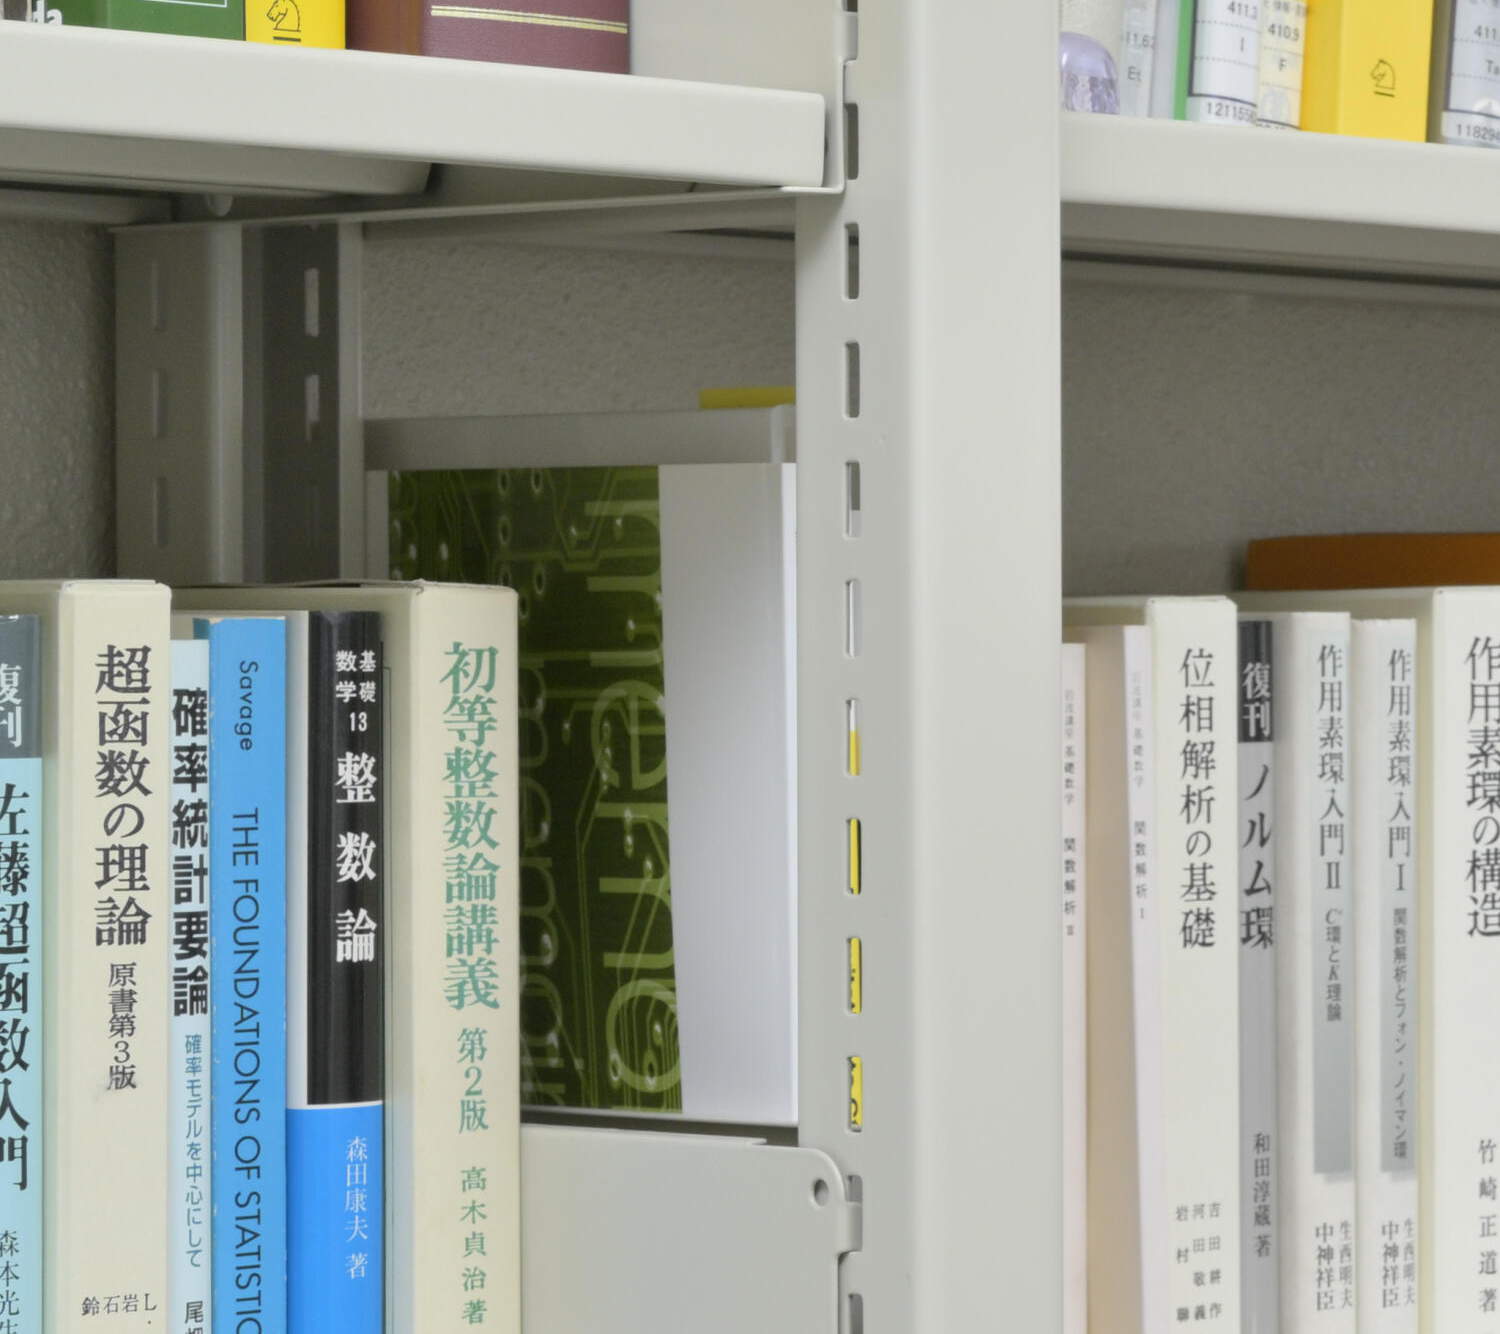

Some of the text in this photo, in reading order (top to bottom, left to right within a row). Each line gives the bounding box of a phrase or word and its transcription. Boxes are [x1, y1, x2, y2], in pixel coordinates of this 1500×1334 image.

[233, 659, 260, 751] Savage
[349, 711, 368, 733] 13
[1317, 643, 1345, 858] 作用素環入門
[1387, 648, 1412, 860] 作用素環入門
[94, 643, 153, 949] 超函数の理論
[172, 686, 209, 1018] 確率統計要論
[231, 808, 260, 866] THE
[334, 751, 377, 963] 整数論
[439, 641, 500, 1012] 初等整数論講義
[1178, 647, 1218, 951] 位相解析の基礎
[1240, 763, 1274, 951] ノルム環
[106, 962, 138, 1091] 原書第3版
[231, 877, 262, 1125] FOUNDATIONS
[457, 1026, 489, 1135] 第2版
[184, 1034, 203, 1269] 確率モデルを中心にして
[233, 1135, 262, 1180] OF
[344, 1135, 369, 1280] 森田康夫 著
[1252, 1132, 1271, 1228] 和田淳蔵
[1478, 1139, 1498, 1277] 竹崎正道
[459, 1165, 489, 1326] 高木貞治著
[1314, 1222, 1336, 1311] 中神祥臣
